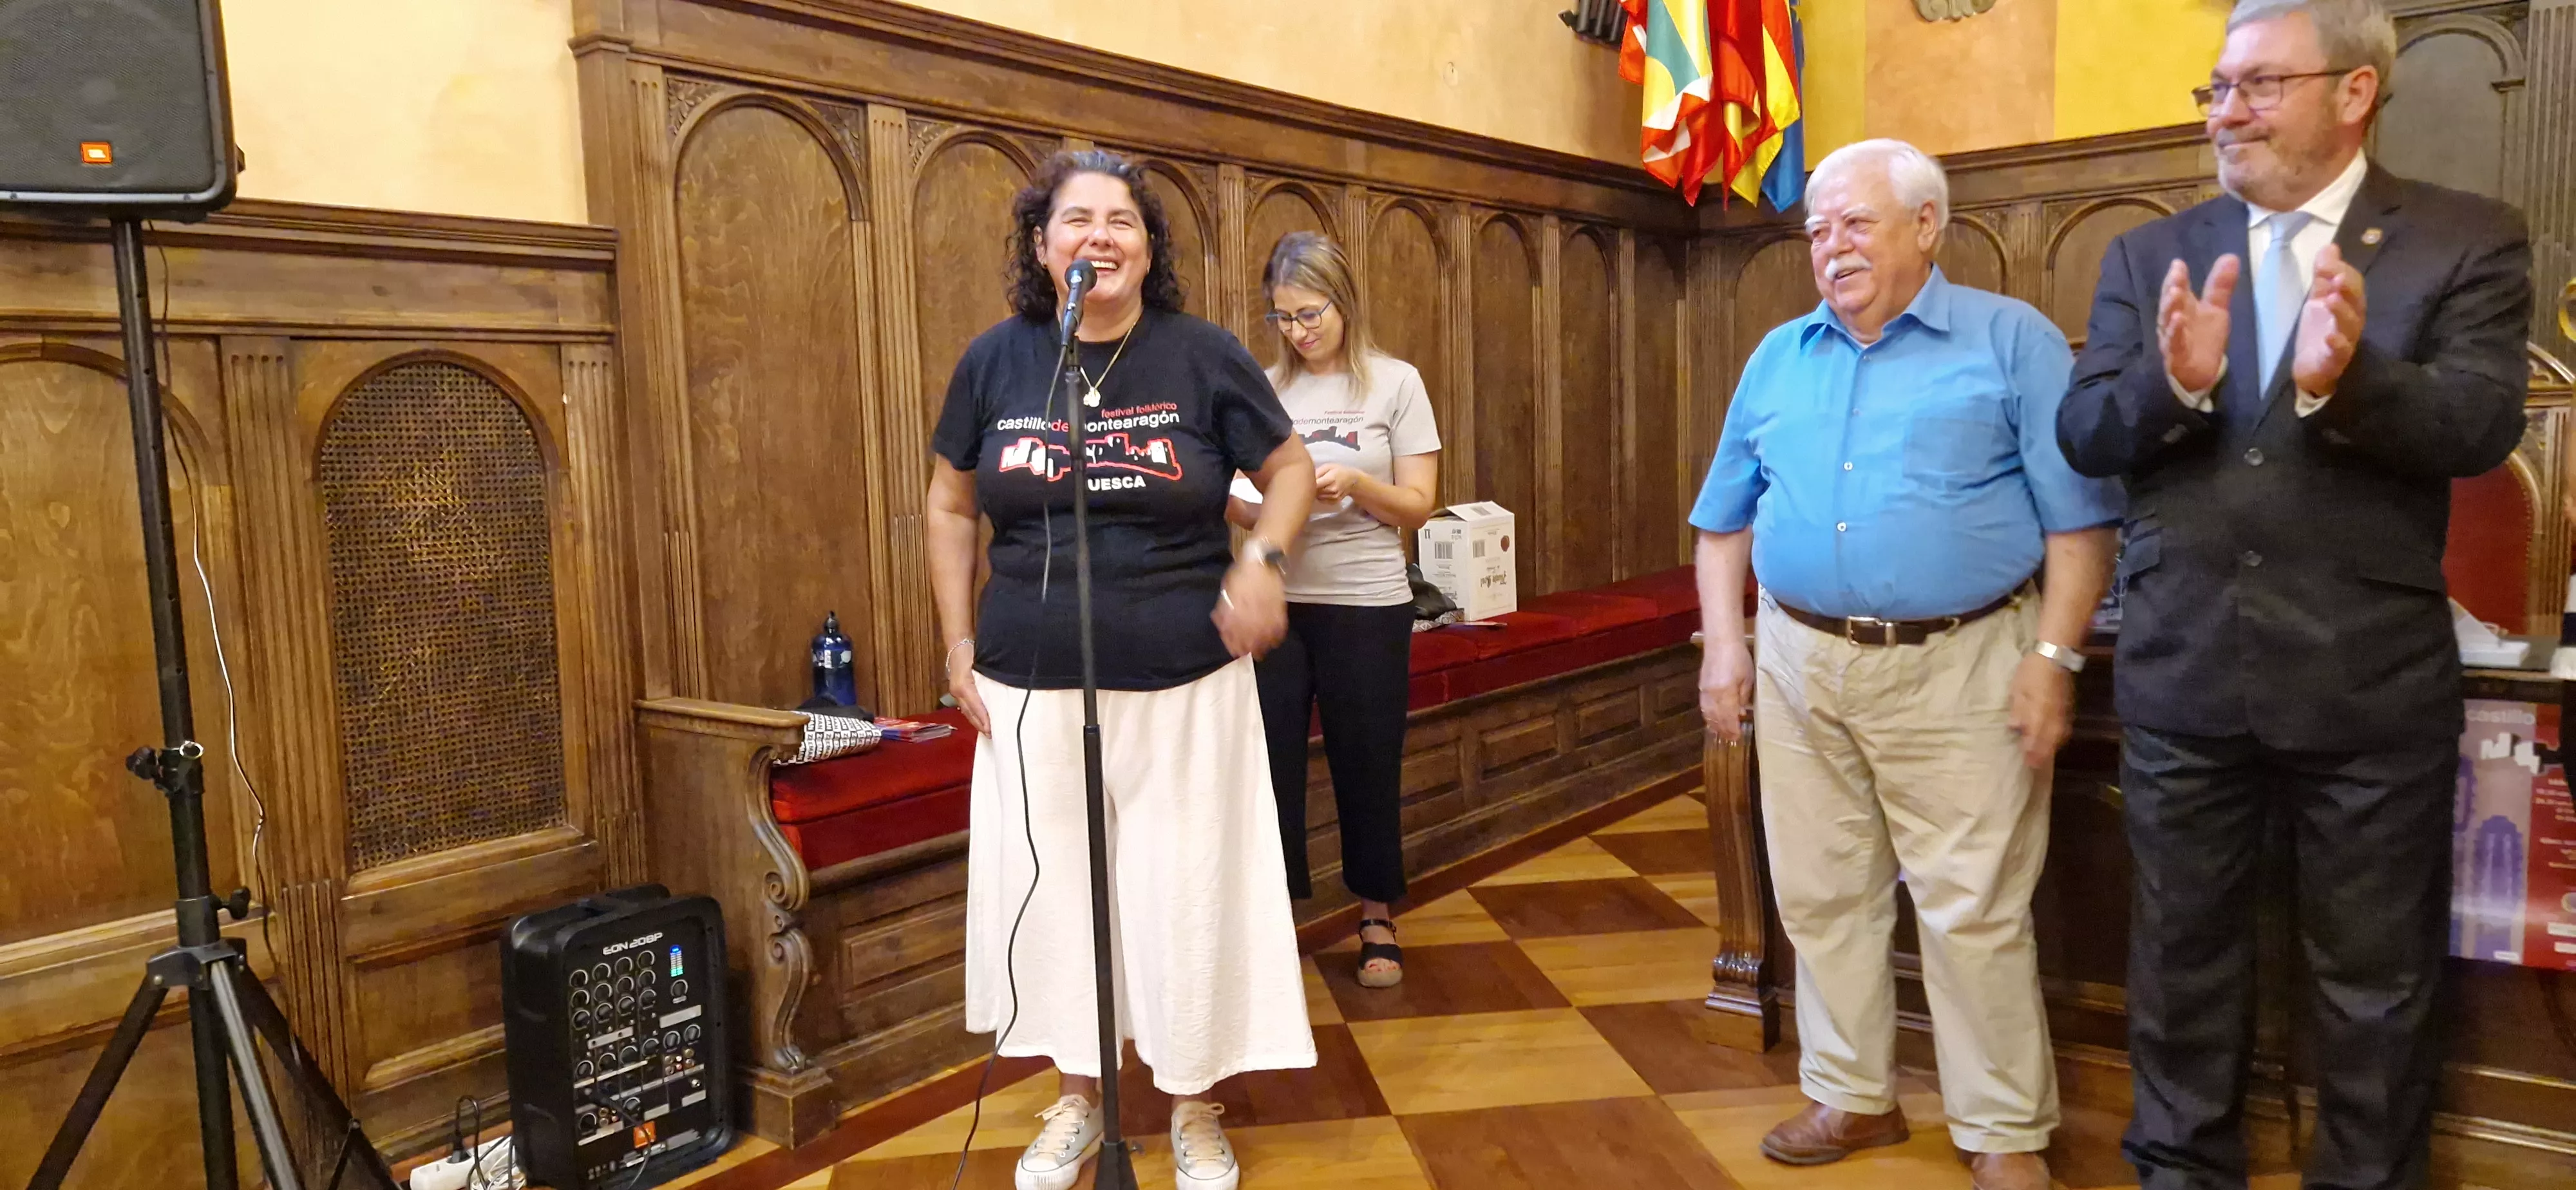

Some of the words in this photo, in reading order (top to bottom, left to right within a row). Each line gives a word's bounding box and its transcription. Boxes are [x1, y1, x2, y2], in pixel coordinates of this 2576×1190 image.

[1087, 475, 1146, 491] UESCA
[603, 941, 629, 956] EON
[629, 932, 663, 949] 208P
